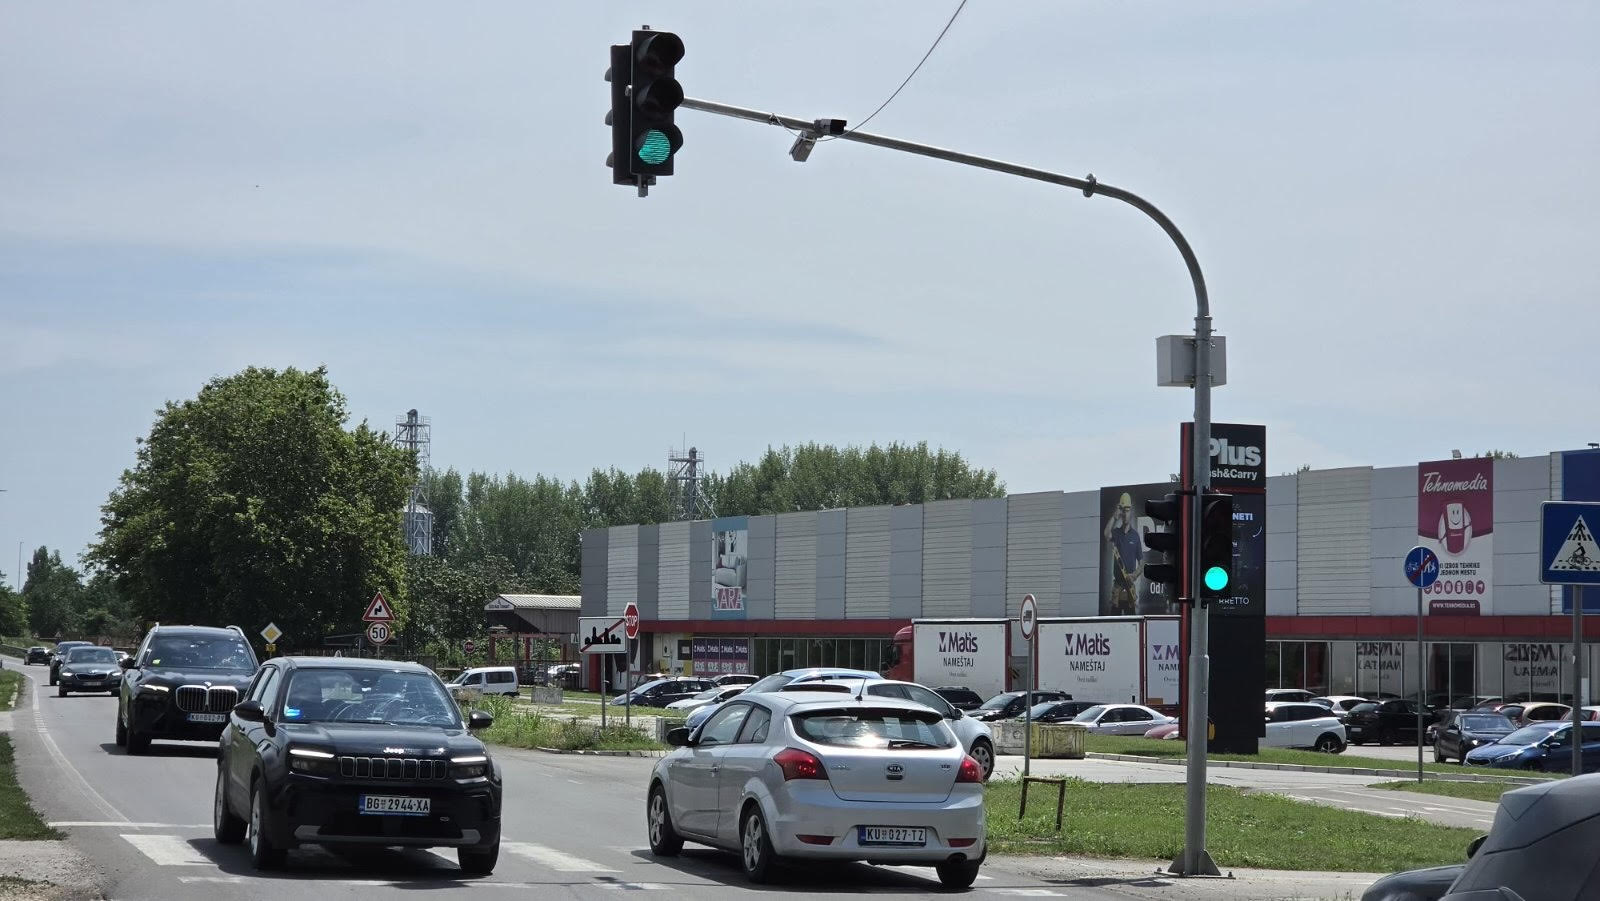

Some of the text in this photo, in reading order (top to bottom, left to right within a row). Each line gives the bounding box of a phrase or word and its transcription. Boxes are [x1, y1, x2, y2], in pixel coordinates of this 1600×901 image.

[1209, 437, 1262, 467] Plus
[1422, 471, 1488, 493] Tehnomedia
[625, 614, 638, 627] STOP
[372, 626, 386, 639] 50
[948, 631, 979, 653] Matis
[1075, 632, 1111, 656] Matis
[1165, 644, 1180, 661] M
[943, 656, 974, 668] NAMEŠTAJ
[1069, 659, 1105, 672] NAMEŠTAJ
[383, 747, 405, 755] Jeep
[366, 797, 380, 809] BG
[866, 829, 881, 840] KU
